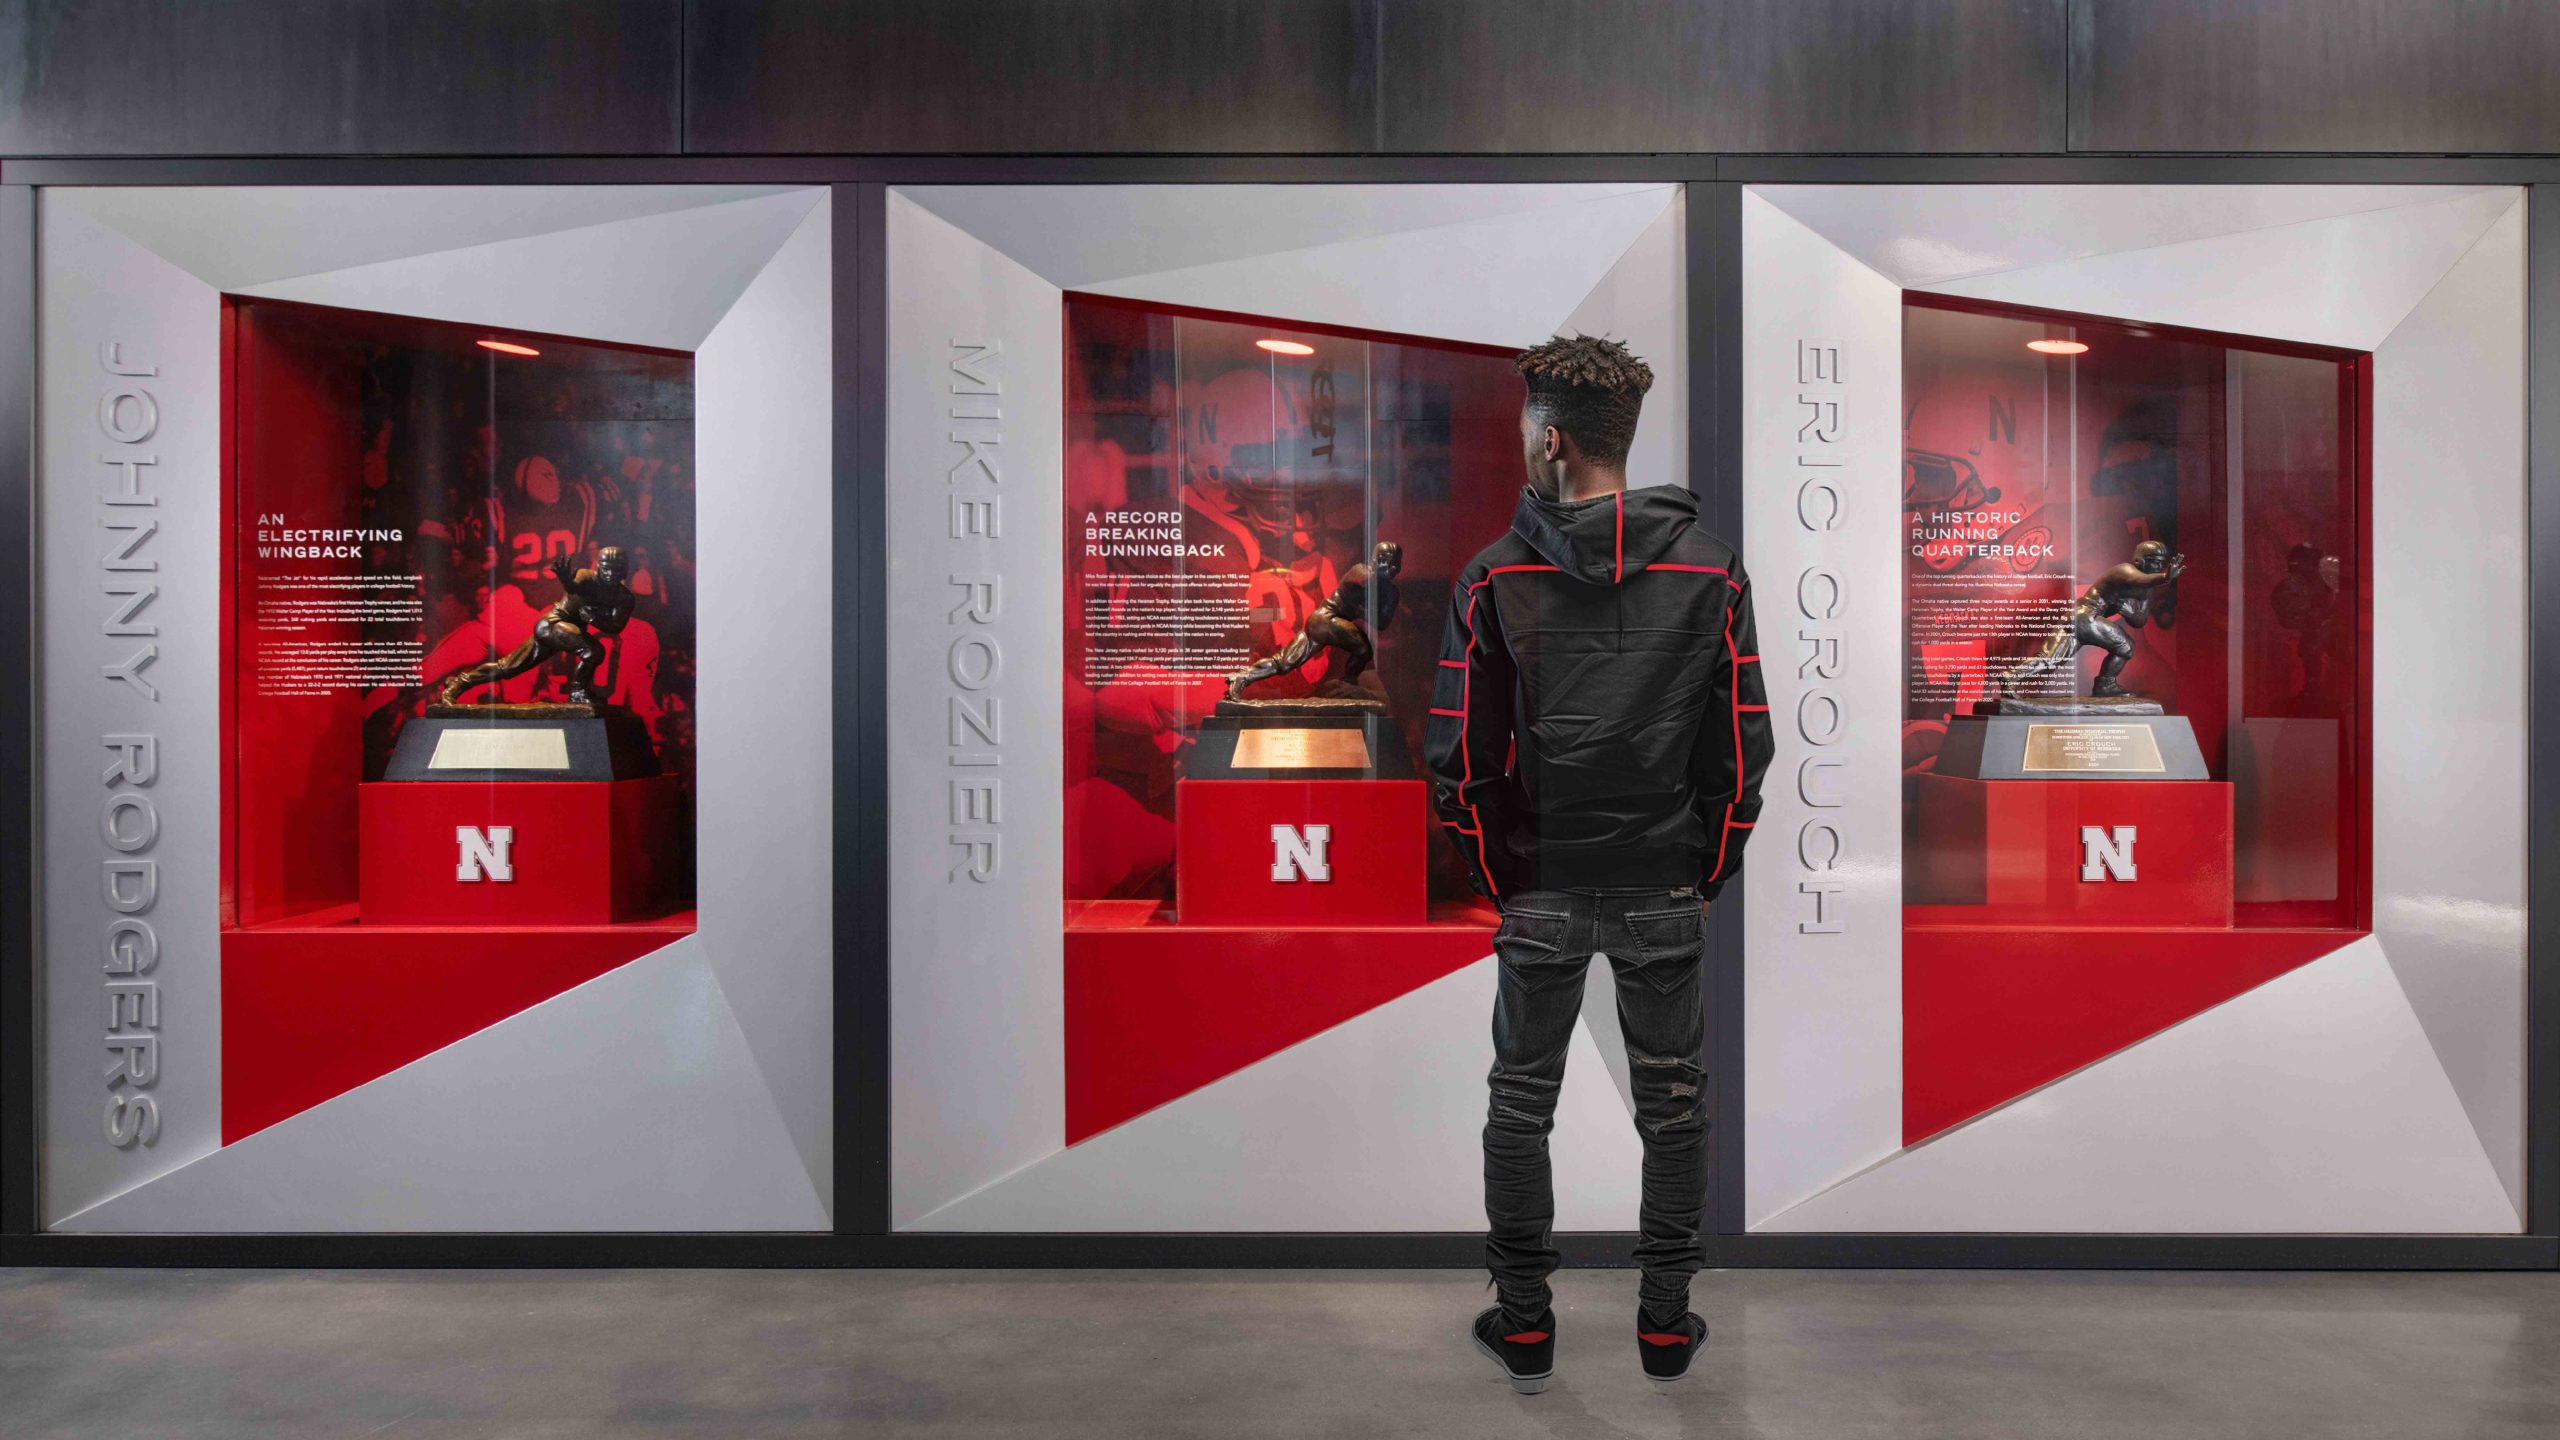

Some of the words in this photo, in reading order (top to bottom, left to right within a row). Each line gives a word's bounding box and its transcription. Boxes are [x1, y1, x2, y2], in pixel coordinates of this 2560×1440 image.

[949, 337, 1001, 538] MIKE
[1199, 402, 1218, 445] N
[1797, 339, 1846, 532] ERIC
[1988, 393, 2018, 446] N
[101, 340, 158, 701] JOHNNY
[257, 513, 284, 526] AN
[258, 529, 403, 542] ELECTRIFYING
[1085, 511, 1098, 524] A
[1105, 511, 1183, 524] RECORD
[1085, 527, 1183, 540] BREAKING
[1912, 511, 1924, 524] A
[1931, 511, 2021, 524] HISTORIC
[1912, 528, 1999, 540] RUNNING
[257, 546, 363, 559] WINGBACK
[1085, 544, 1226, 557] RUNNINGBACK
[1911, 544, 2054, 557] QUARTERBACK
[949, 574, 1001, 884] ROZIER
[1797, 565, 1847, 935] CROUCH
[456, 826, 513, 882] N
[1271, 824, 1330, 882] N
[2082, 826, 2138, 882] N
[102, 734, 161, 1149] RODGERS
